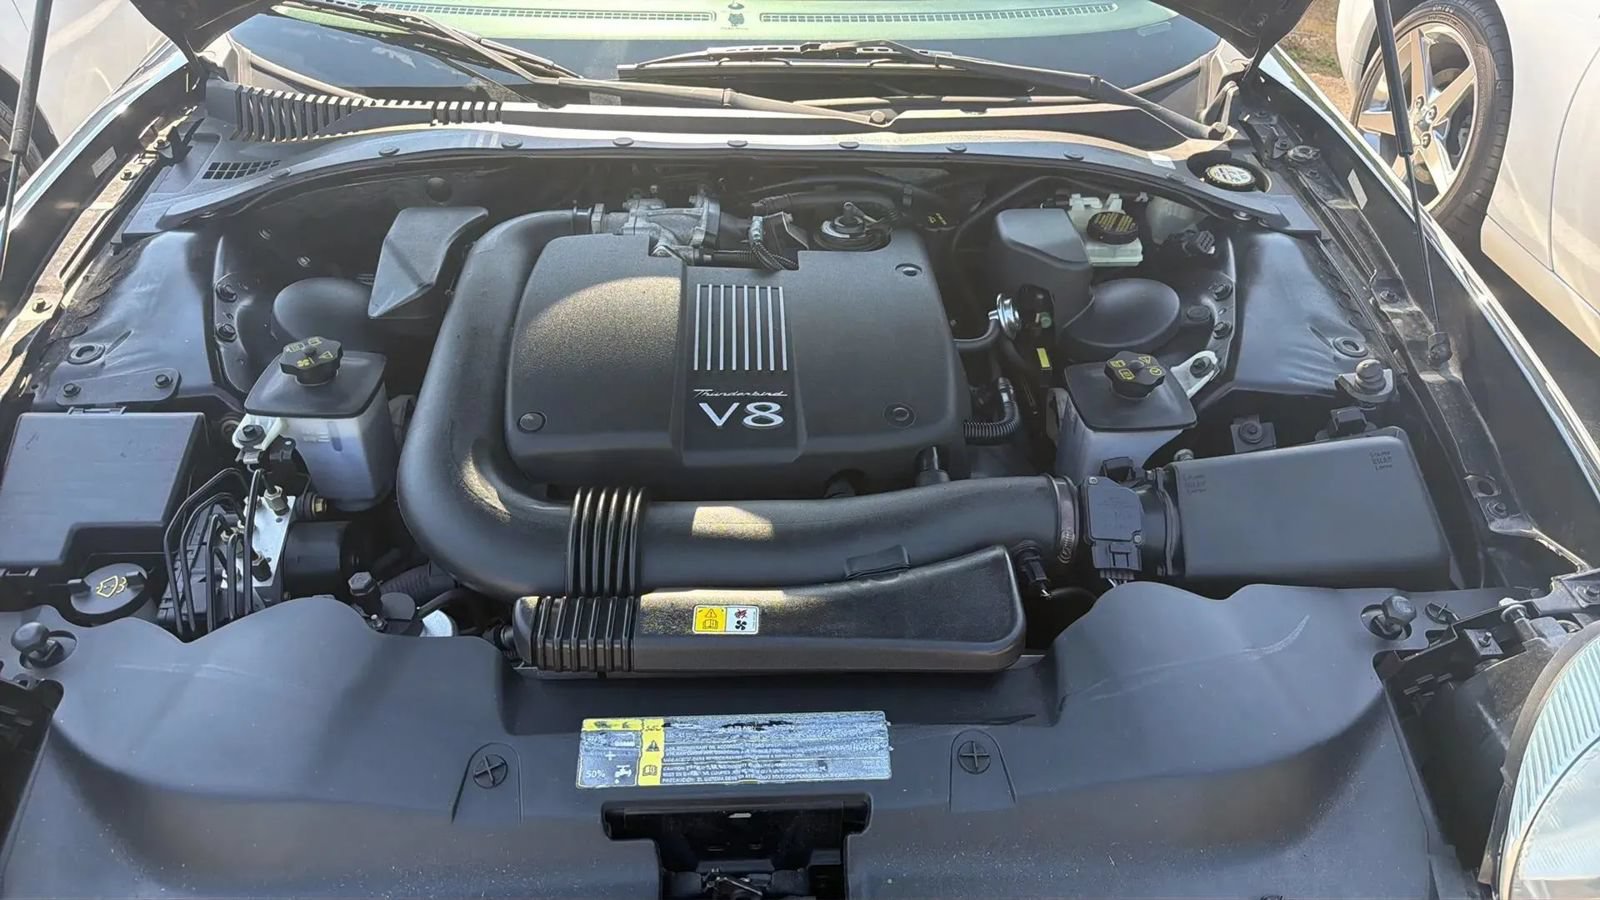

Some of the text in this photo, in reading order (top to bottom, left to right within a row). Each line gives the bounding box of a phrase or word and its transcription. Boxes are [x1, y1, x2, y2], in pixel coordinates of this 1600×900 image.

[693, 389, 788, 398] Thunderbird
[699, 401, 784, 428] V8
[585, 769, 606, 778] 50%
